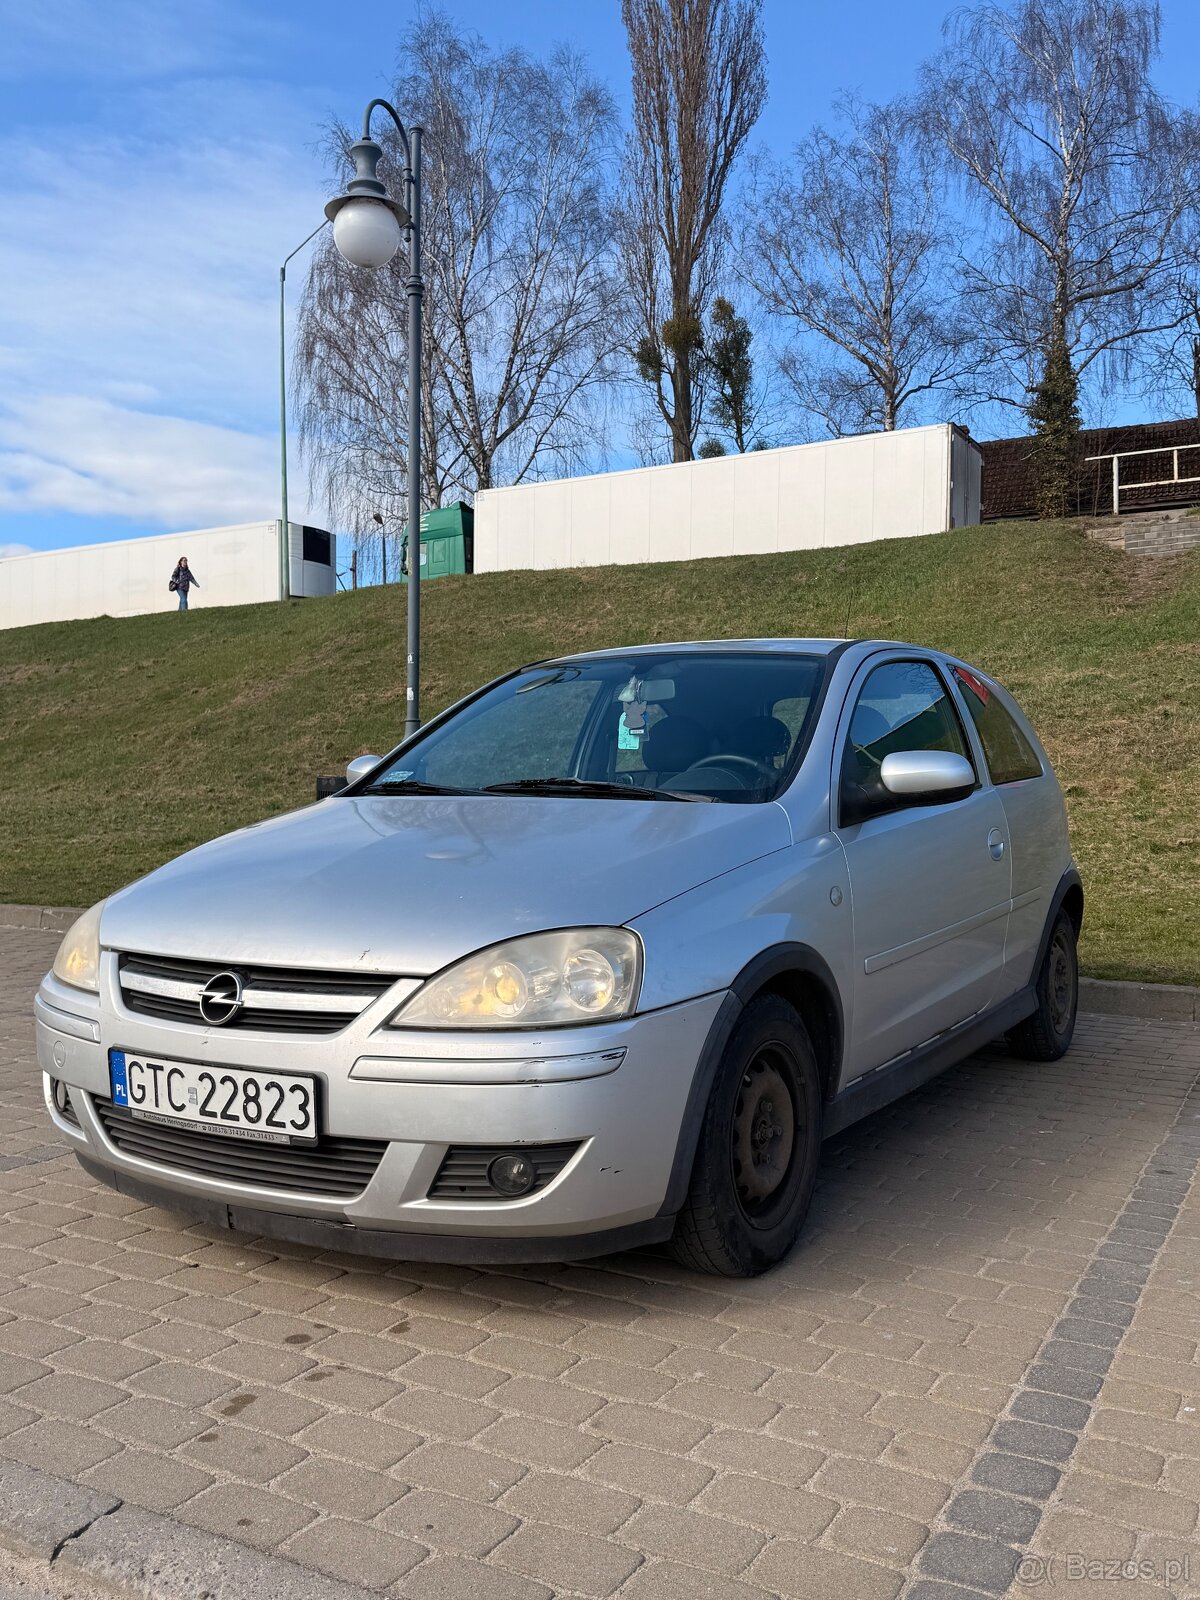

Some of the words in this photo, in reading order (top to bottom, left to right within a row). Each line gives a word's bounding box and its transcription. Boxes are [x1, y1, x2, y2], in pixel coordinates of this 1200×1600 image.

[116, 1084, 127, 1097] PL
[128, 1060, 187, 1112] GTC
[198, 1072, 310, 1131] 22823
[143, 1112, 167, 1124] Autohaus
